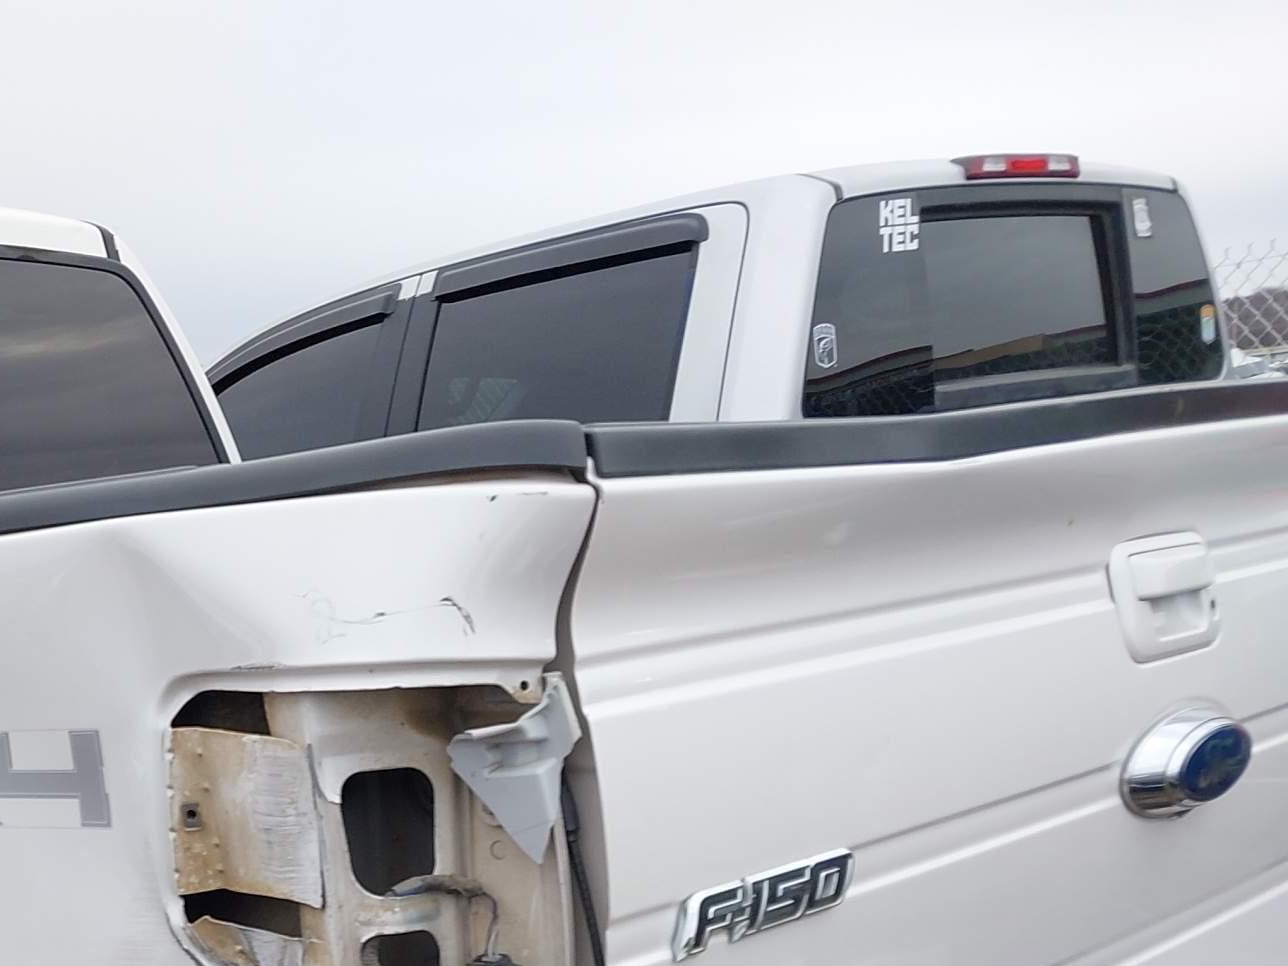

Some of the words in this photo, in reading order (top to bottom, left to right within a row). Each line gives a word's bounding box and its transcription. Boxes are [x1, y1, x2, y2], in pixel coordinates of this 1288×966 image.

[880, 198, 919, 226] KEL
[880, 224, 920, 252] TEC
[671, 847, 855, 961] F-150
